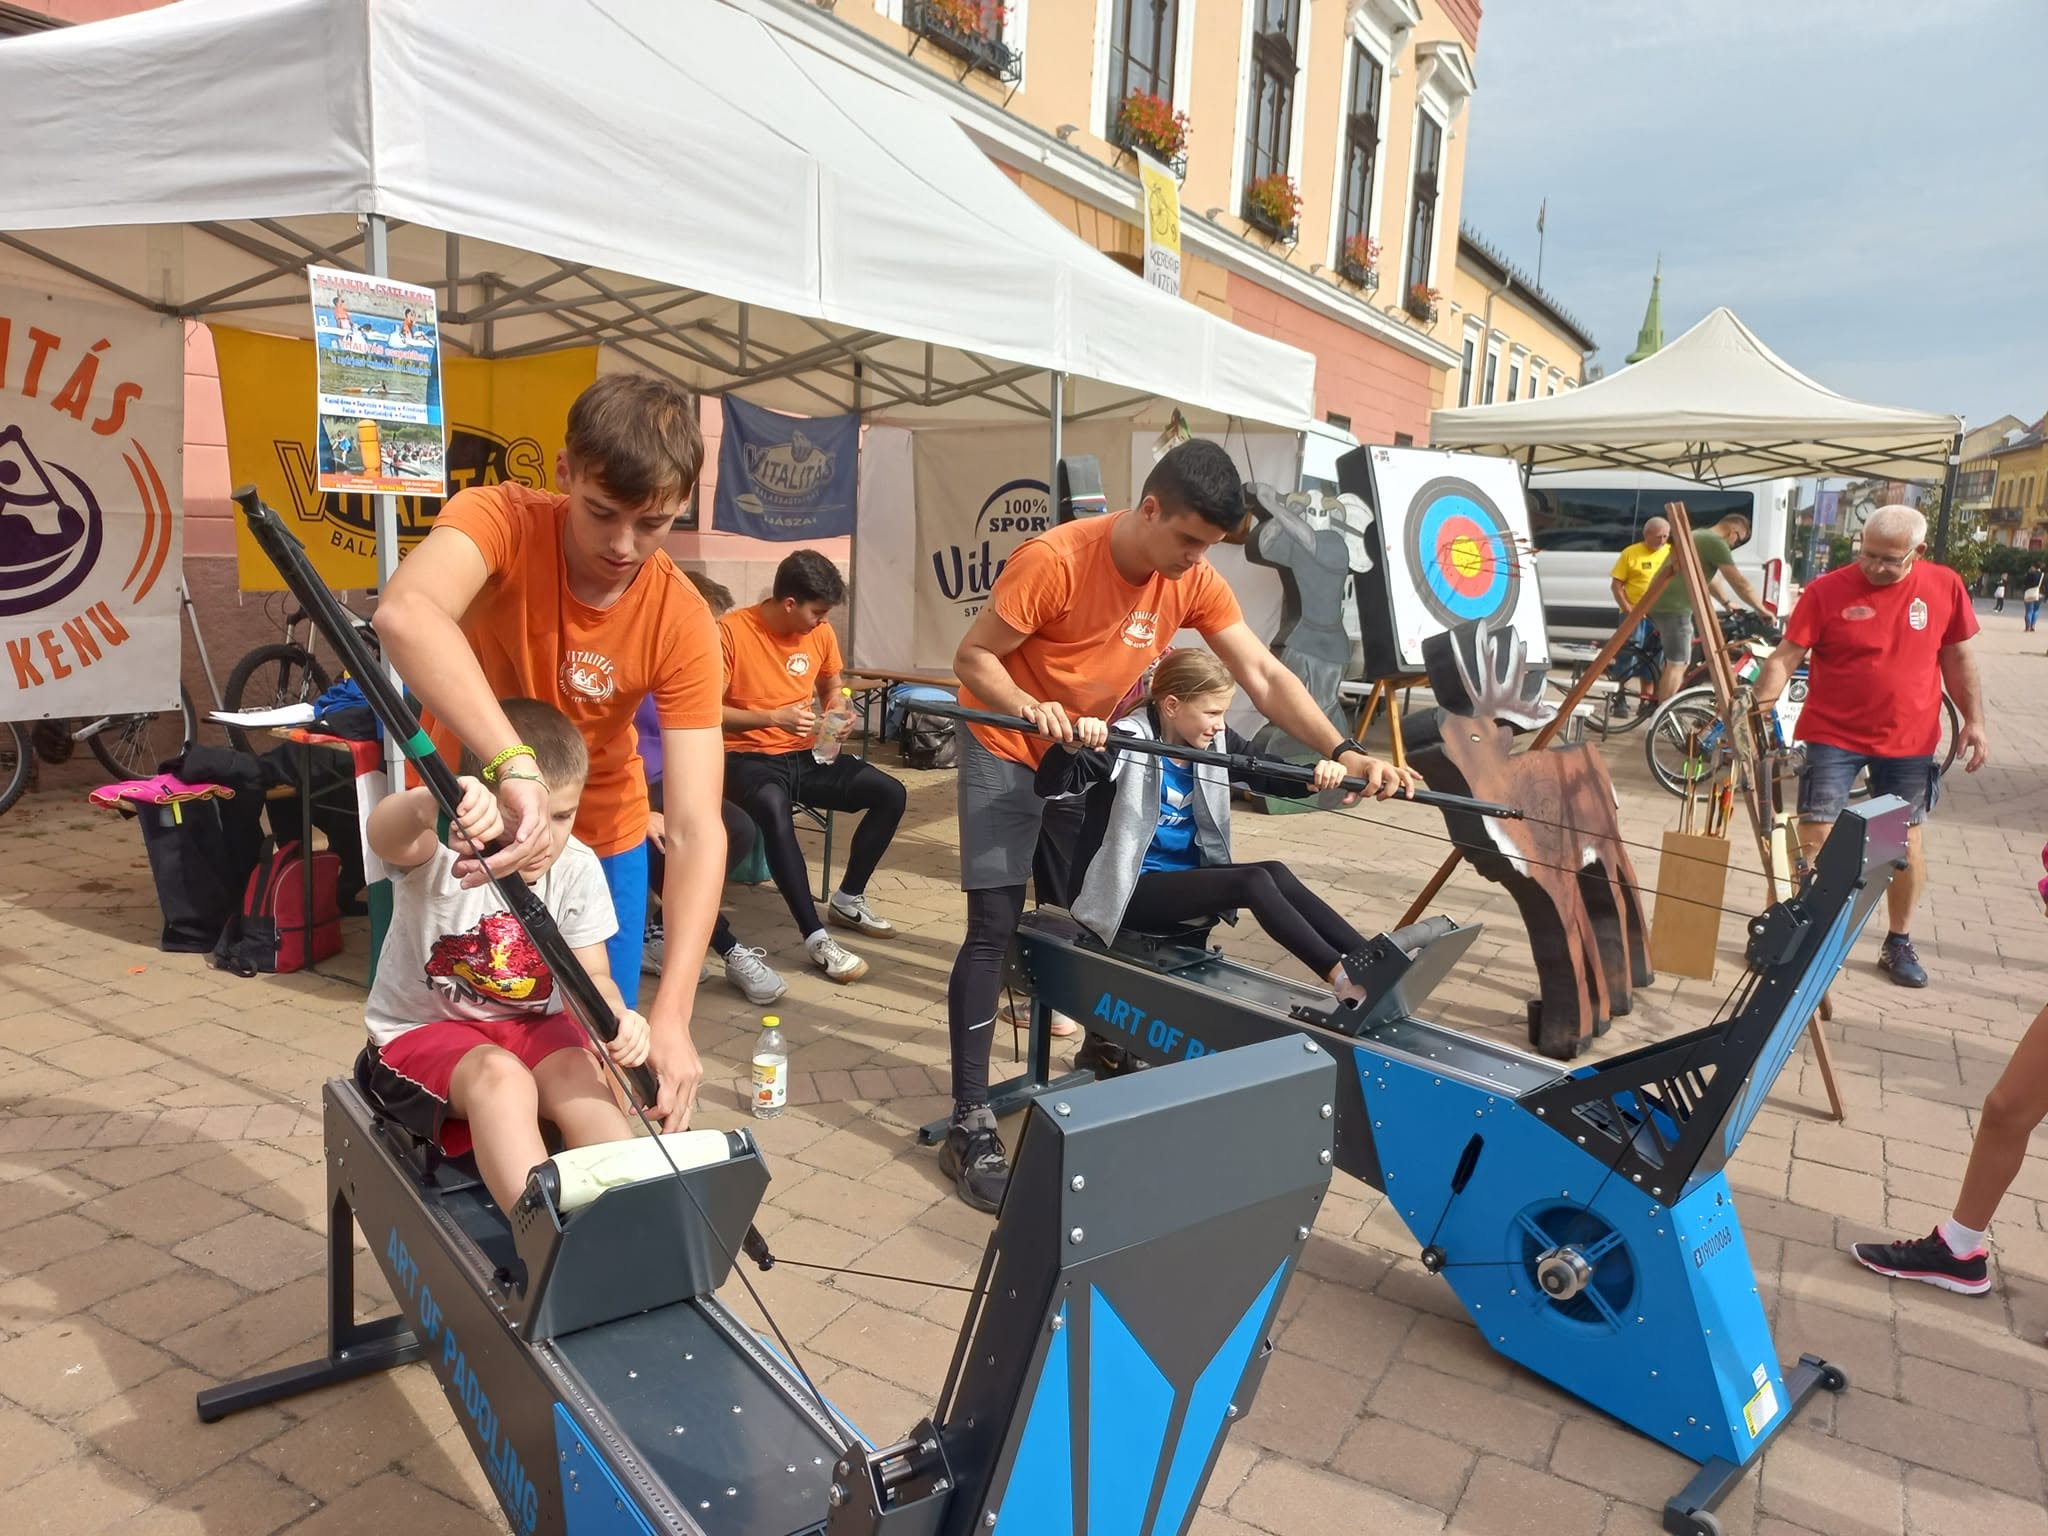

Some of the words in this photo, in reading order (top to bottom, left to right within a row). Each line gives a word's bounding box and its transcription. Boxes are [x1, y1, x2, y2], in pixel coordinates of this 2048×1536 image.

[989, 516, 1050, 532] SPOR
[1004, 499, 1048, 515] 100%
[6, 600, 130, 690] KENU
[566, 650, 614, 675] VITALITÁS
[1093, 992, 1147, 1036] ART
[1148, 1019, 1184, 1054] OF
[387, 1226, 419, 1298] ART
[420, 1284, 442, 1341] OF
[443, 1327, 539, 1533] PADDLING
